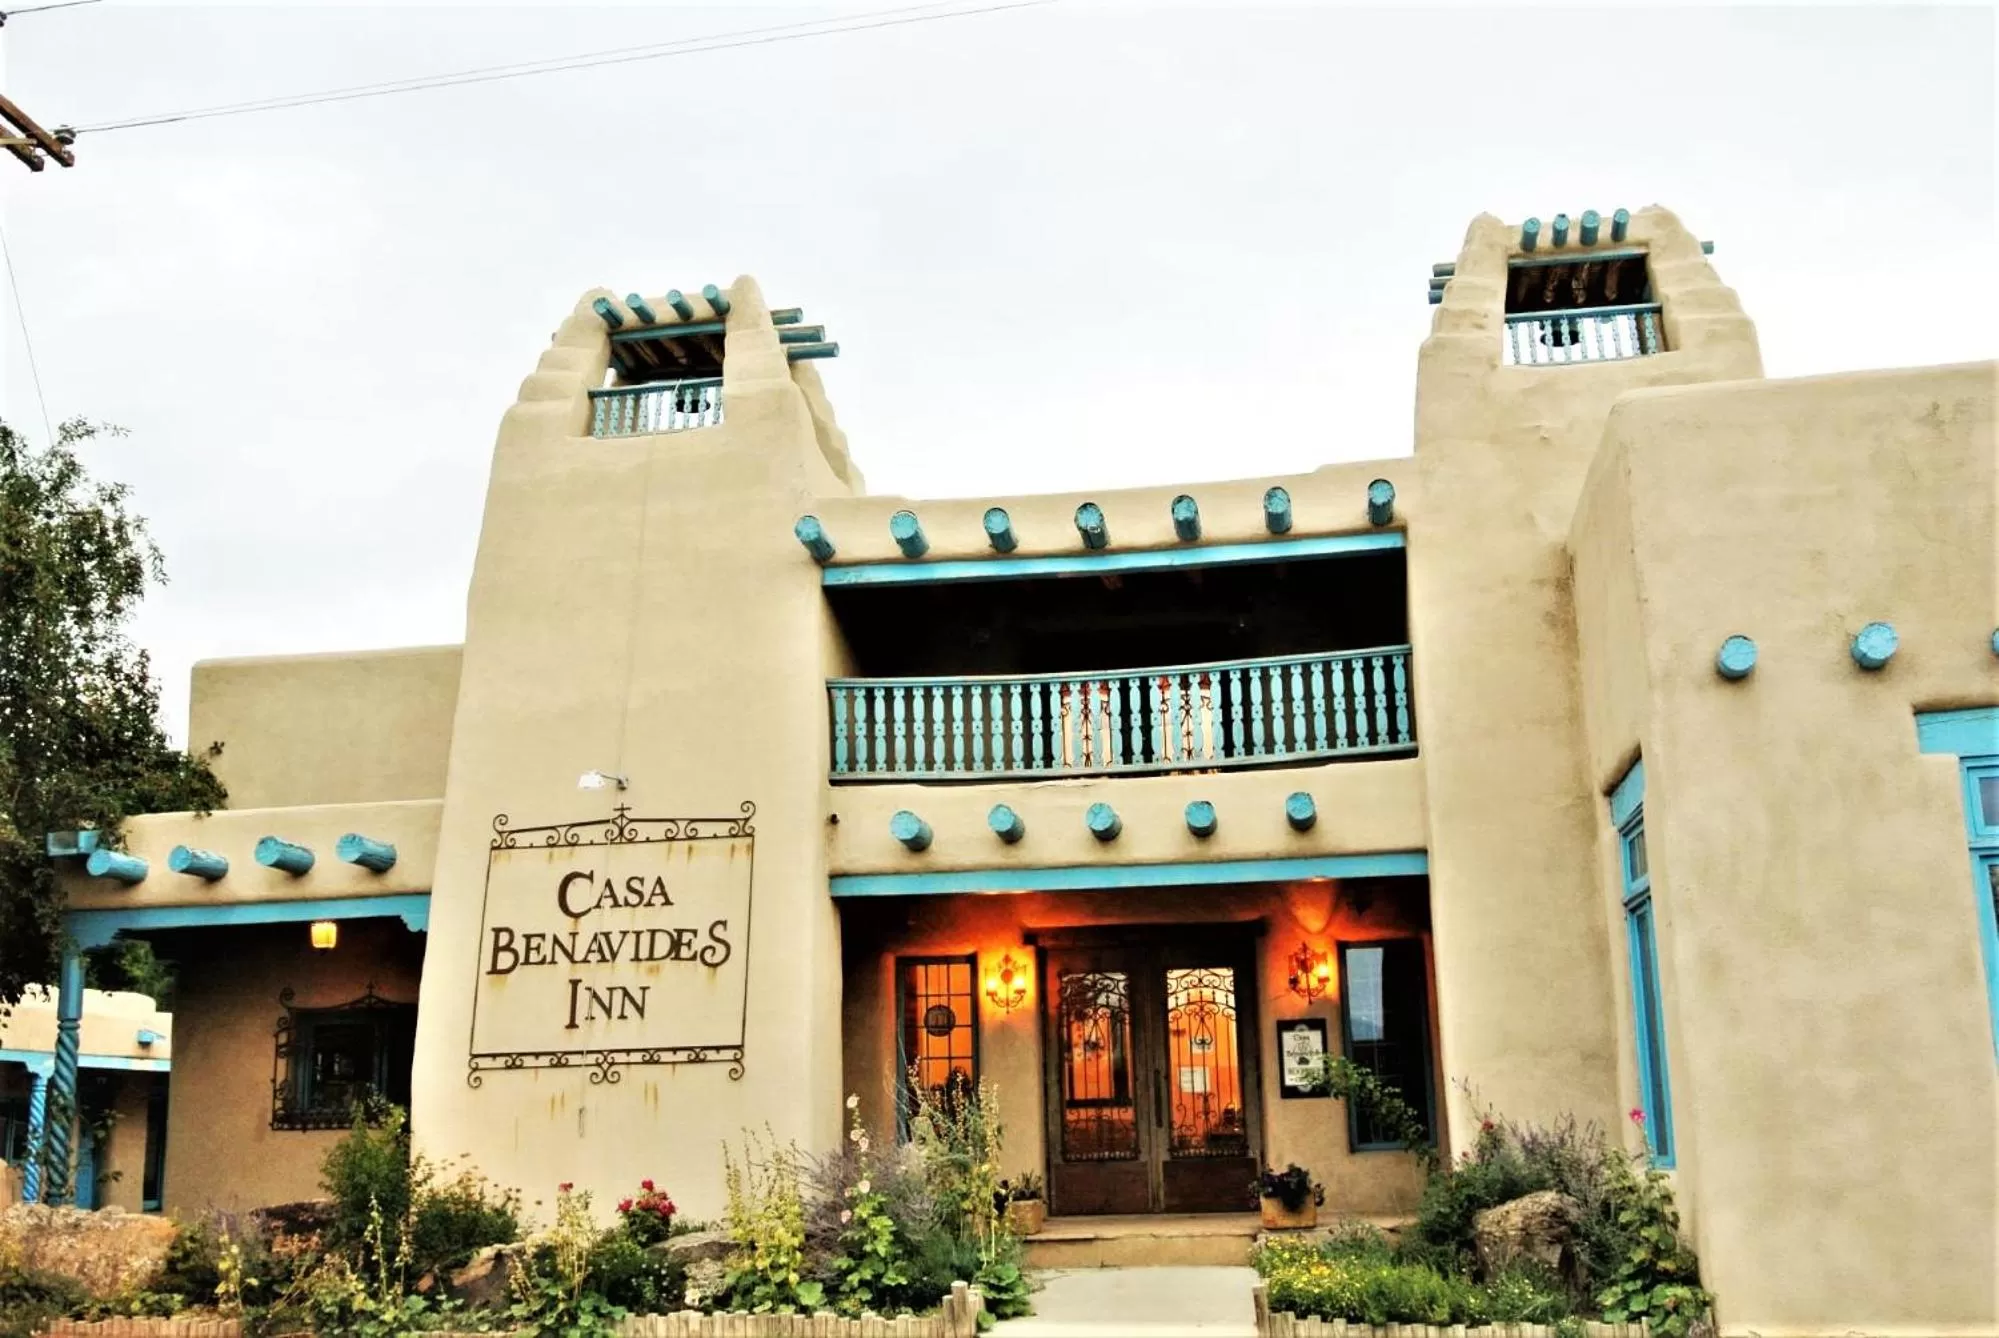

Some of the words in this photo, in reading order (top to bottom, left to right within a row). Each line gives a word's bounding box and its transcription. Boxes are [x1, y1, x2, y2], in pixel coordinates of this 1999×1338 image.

[557, 869, 674, 919] CASA
[486, 920, 731, 975] BENAVIDES
[564, 978, 650, 1029] INN
